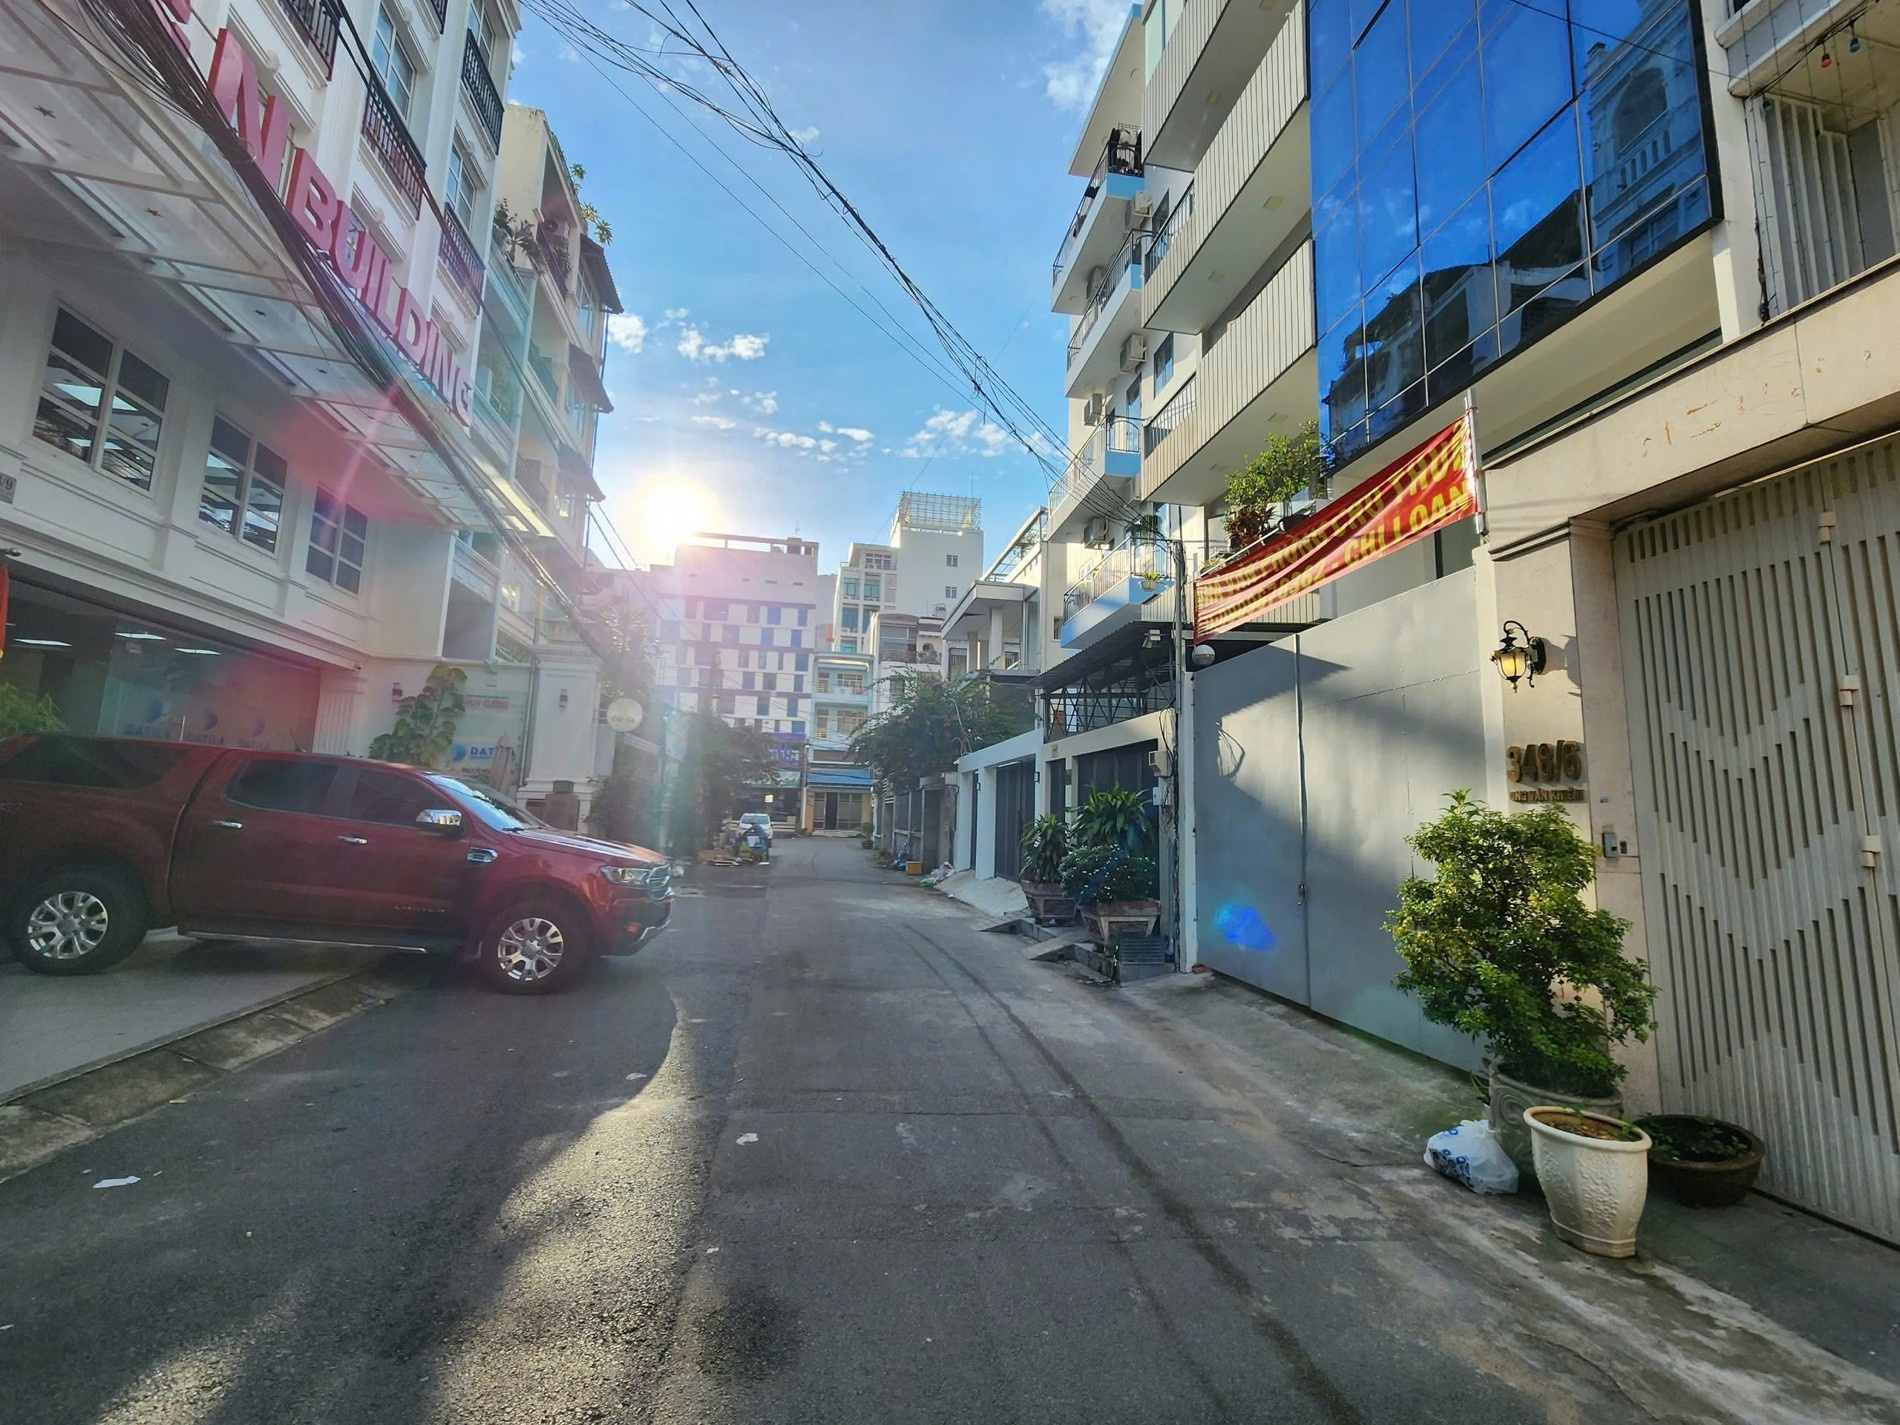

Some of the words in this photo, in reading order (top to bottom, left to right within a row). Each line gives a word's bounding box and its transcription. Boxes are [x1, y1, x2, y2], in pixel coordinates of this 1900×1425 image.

[286, 148, 473, 428] BUILDING
[1393, 479, 1472, 546] LOAN
[470, 746, 517, 757] DATA
[1506, 739, 1582, 783] 348/6
